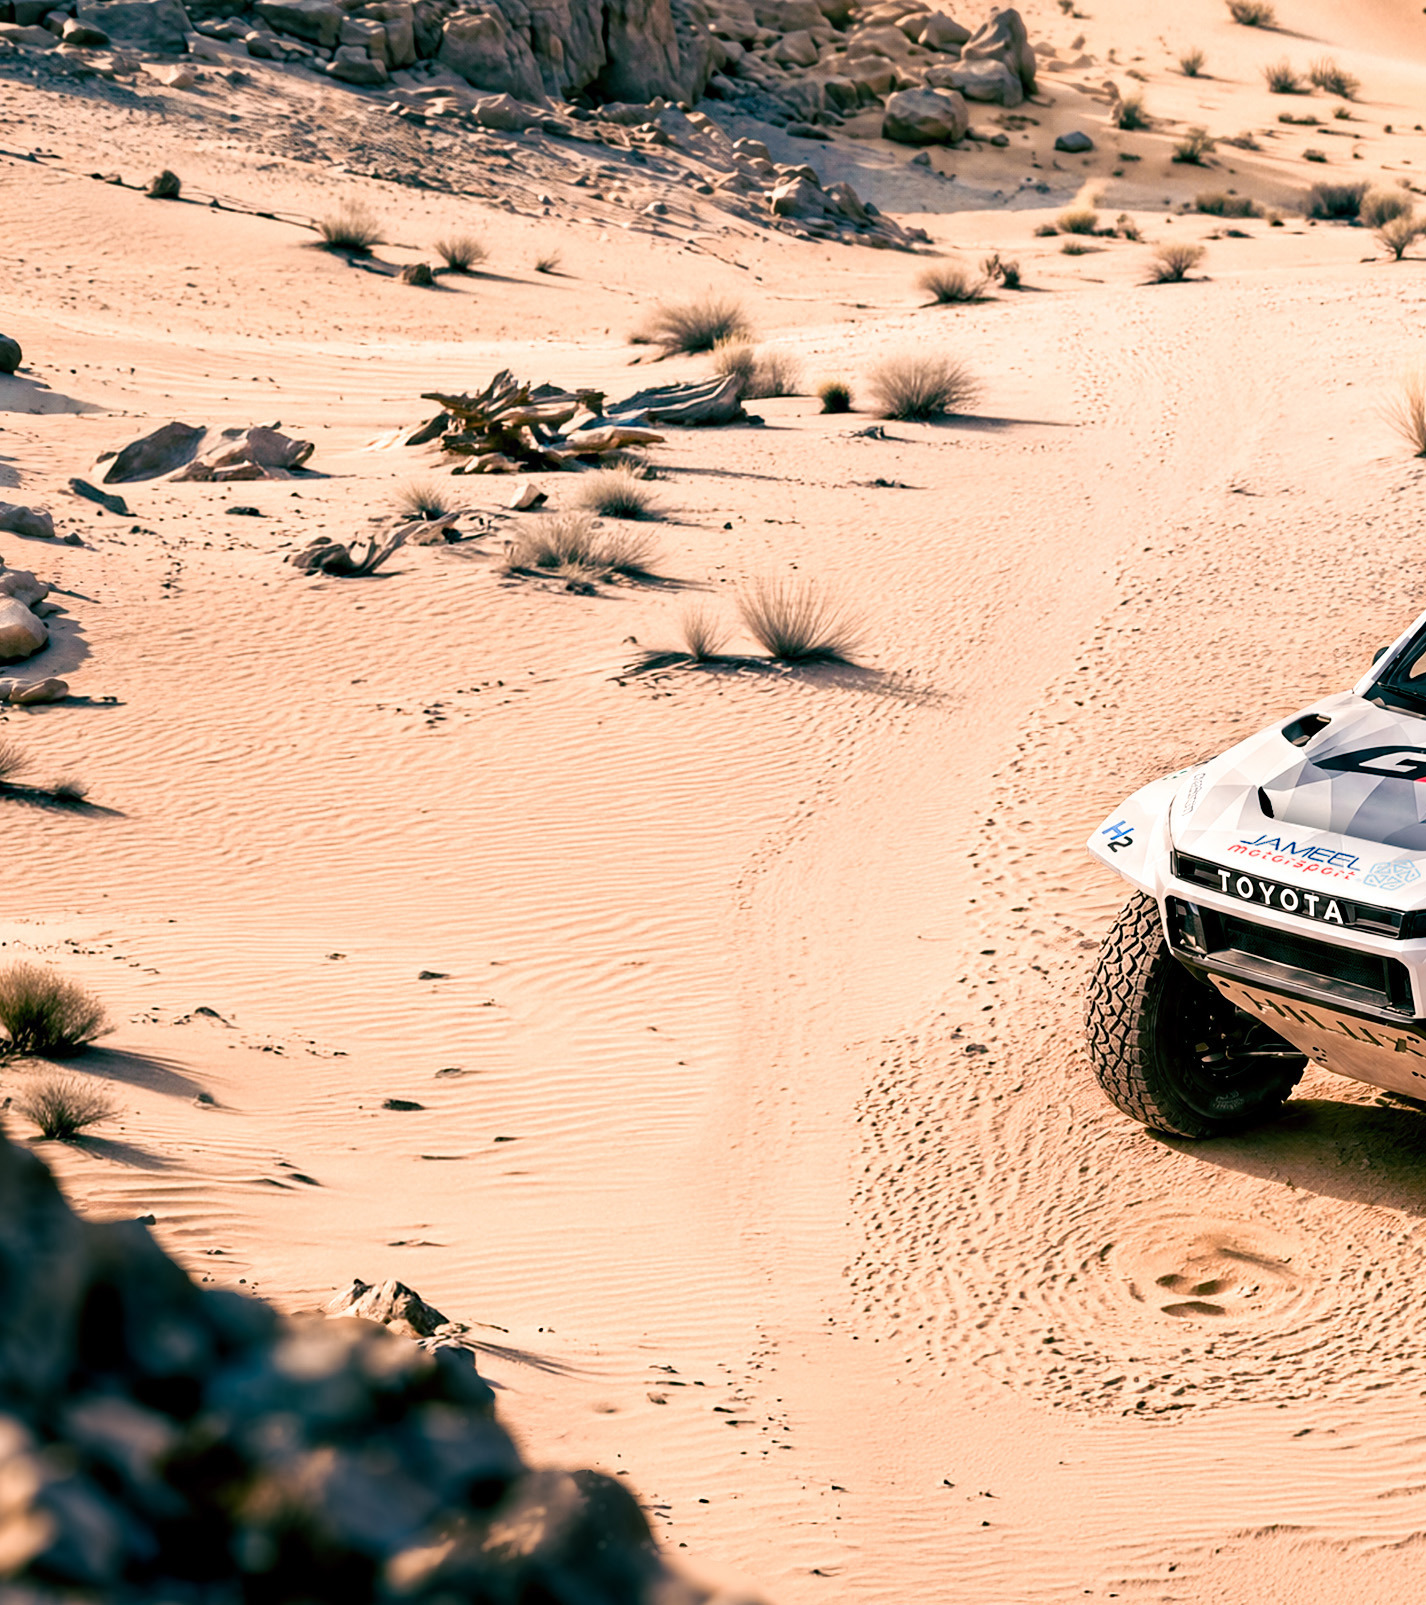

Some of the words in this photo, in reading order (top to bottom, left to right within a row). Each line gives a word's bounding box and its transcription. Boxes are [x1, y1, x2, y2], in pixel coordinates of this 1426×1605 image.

[1102, 820, 1135, 853] H2
[1240, 834, 1361, 872] JAMEEL
[1227, 844, 1356, 881] motorsport
[1217, 869, 1345, 925] TOYOTA
